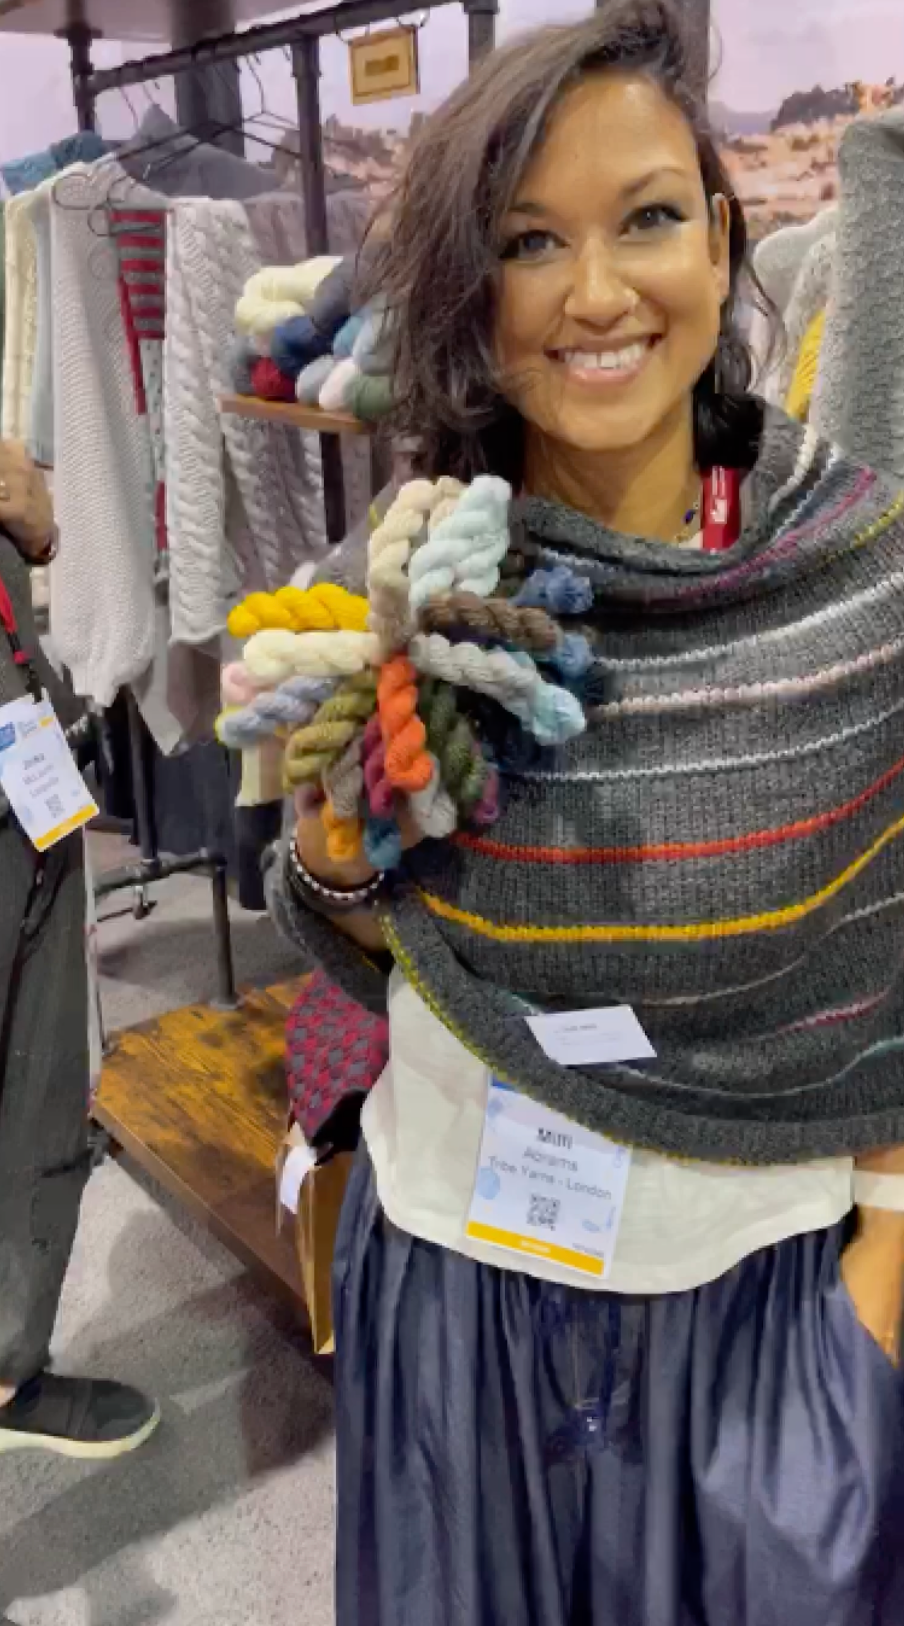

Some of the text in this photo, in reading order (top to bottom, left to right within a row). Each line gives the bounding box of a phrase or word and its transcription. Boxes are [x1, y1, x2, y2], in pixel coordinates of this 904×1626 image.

[523, 1147, 578, 1171] Abrams
[488, 1155, 517, 1174] Tribe
[521, 1164, 555, 1183] Yarns
[564, 1177, 612, 1200] London
